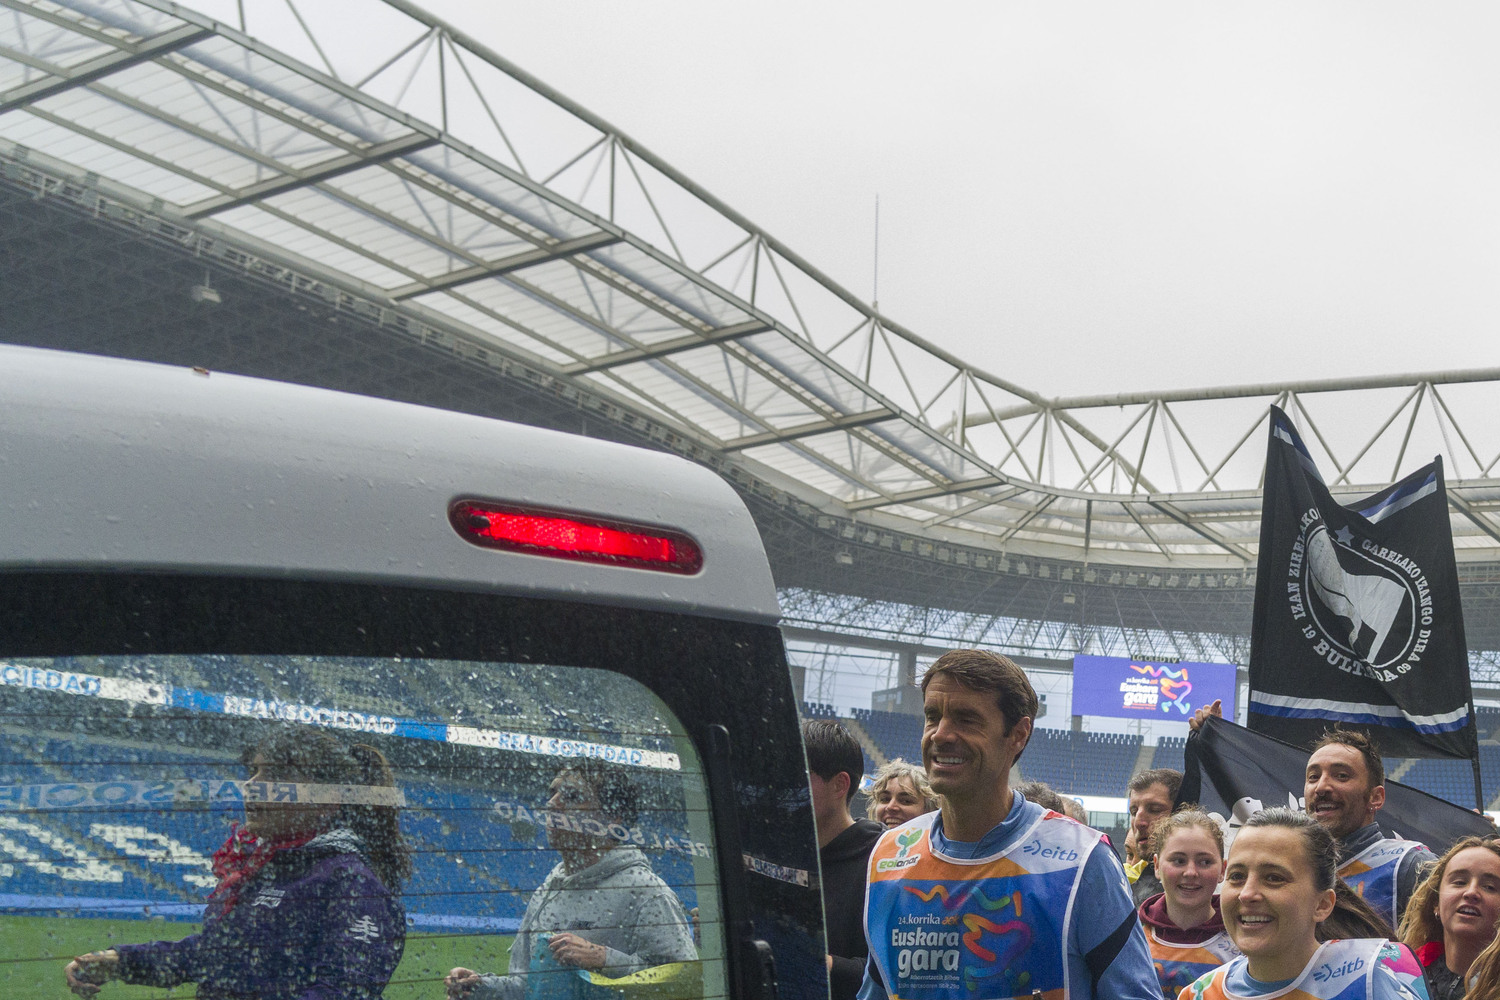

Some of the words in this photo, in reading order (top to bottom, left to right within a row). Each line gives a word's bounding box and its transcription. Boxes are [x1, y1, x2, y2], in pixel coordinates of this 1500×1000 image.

[1288, 508, 1320, 577] ZIRELAKO
[1361, 538, 1421, 578] GARELAKO
[1287, 582, 1306, 620] IZAN
[1415, 576, 1433, 625] IZANGO
[1408, 629, 1431, 662] DIRA
[499, 732, 544, 753] REAL
[1042, 845, 1078, 862] eitb
[898, 914, 941, 925] 24.korrika
[892, 926, 959, 947] Euskara
[897, 948, 959, 978] gara
[1331, 957, 1364, 978] eitb
